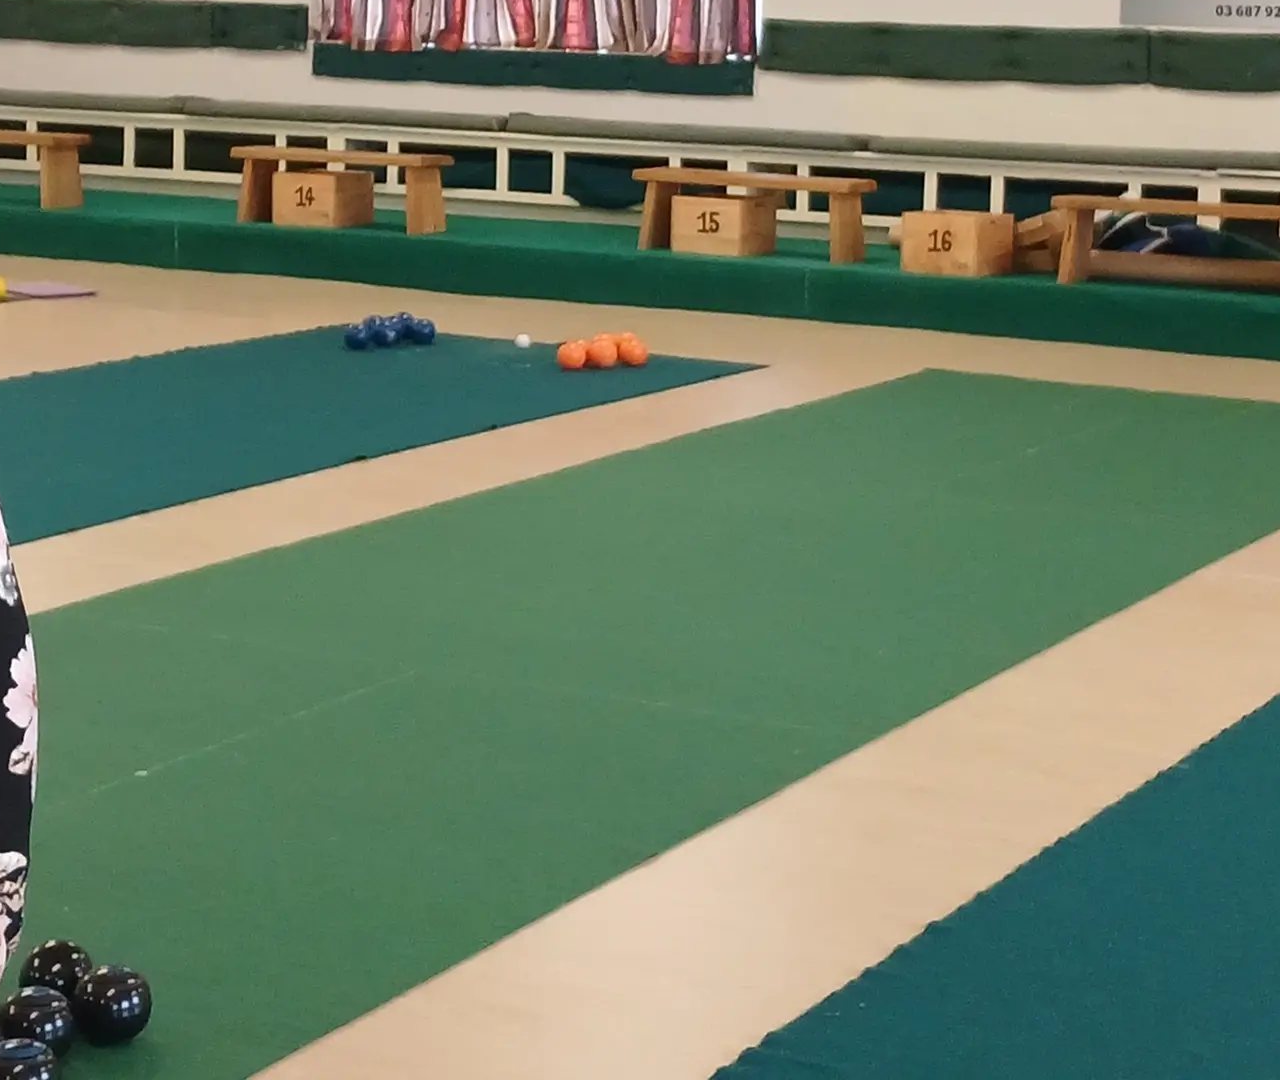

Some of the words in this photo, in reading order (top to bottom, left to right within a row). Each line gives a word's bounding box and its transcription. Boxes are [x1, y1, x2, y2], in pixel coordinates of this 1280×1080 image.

[1215, 5, 1233, 17] 03
[1235, 5, 1261, 17] 687
[294, 185, 316, 208] 14
[696, 211, 720, 233] 15
[927, 229, 952, 253] 16
